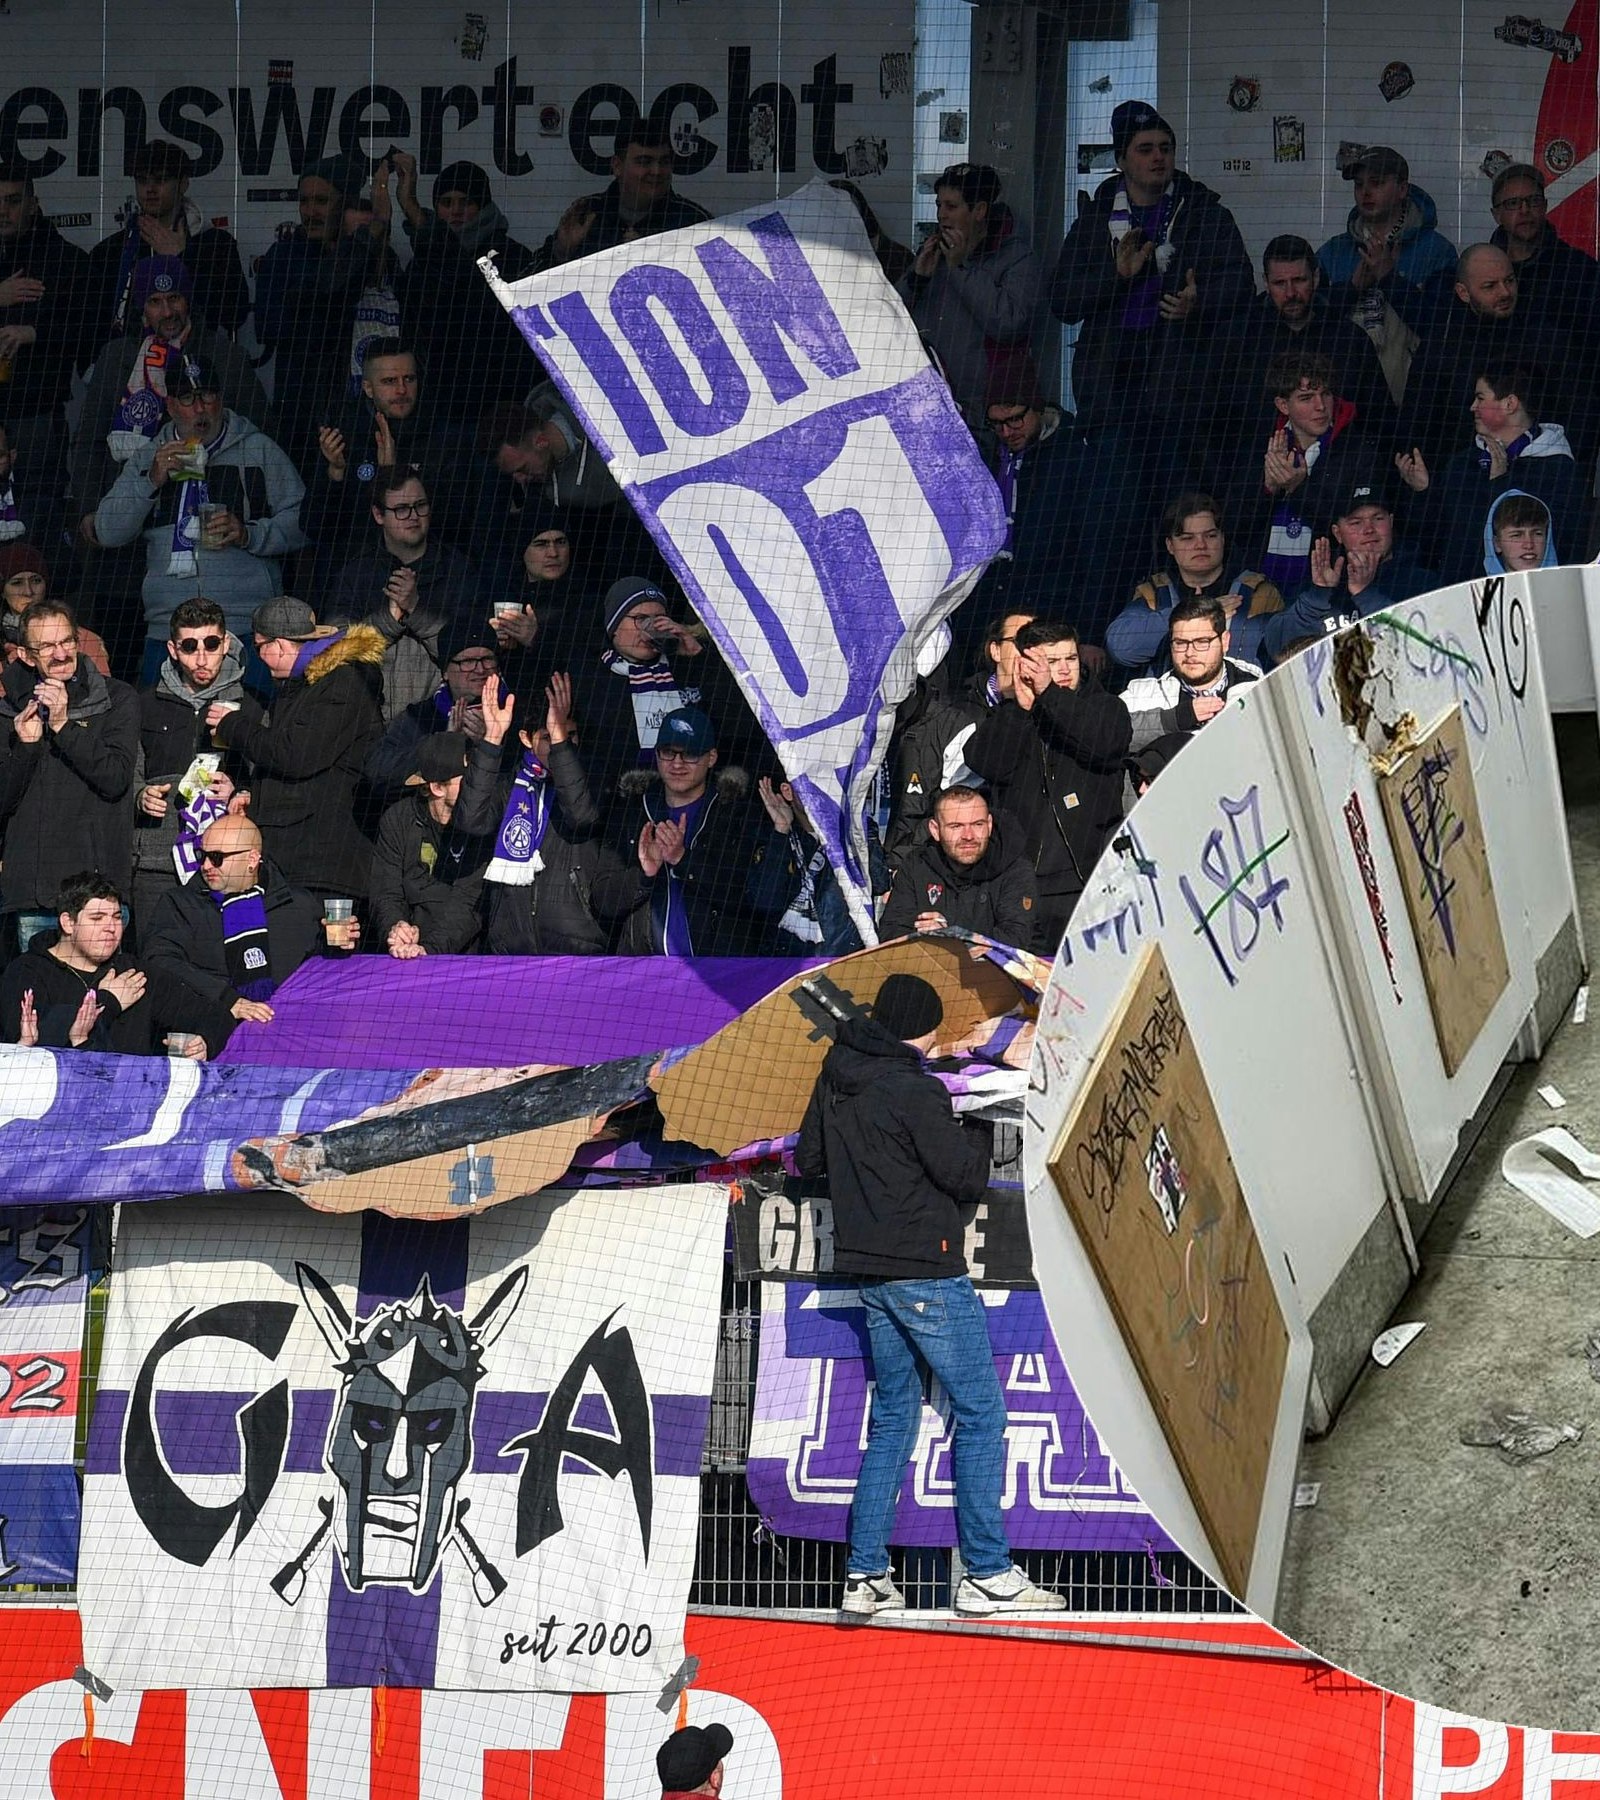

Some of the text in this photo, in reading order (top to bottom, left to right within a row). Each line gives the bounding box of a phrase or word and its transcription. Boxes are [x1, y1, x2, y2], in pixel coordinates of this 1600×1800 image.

[569, 47, 853, 176] echt
[1179, 784, 1291, 988] 187
[500, 1615, 653, 1664] seit 2000
